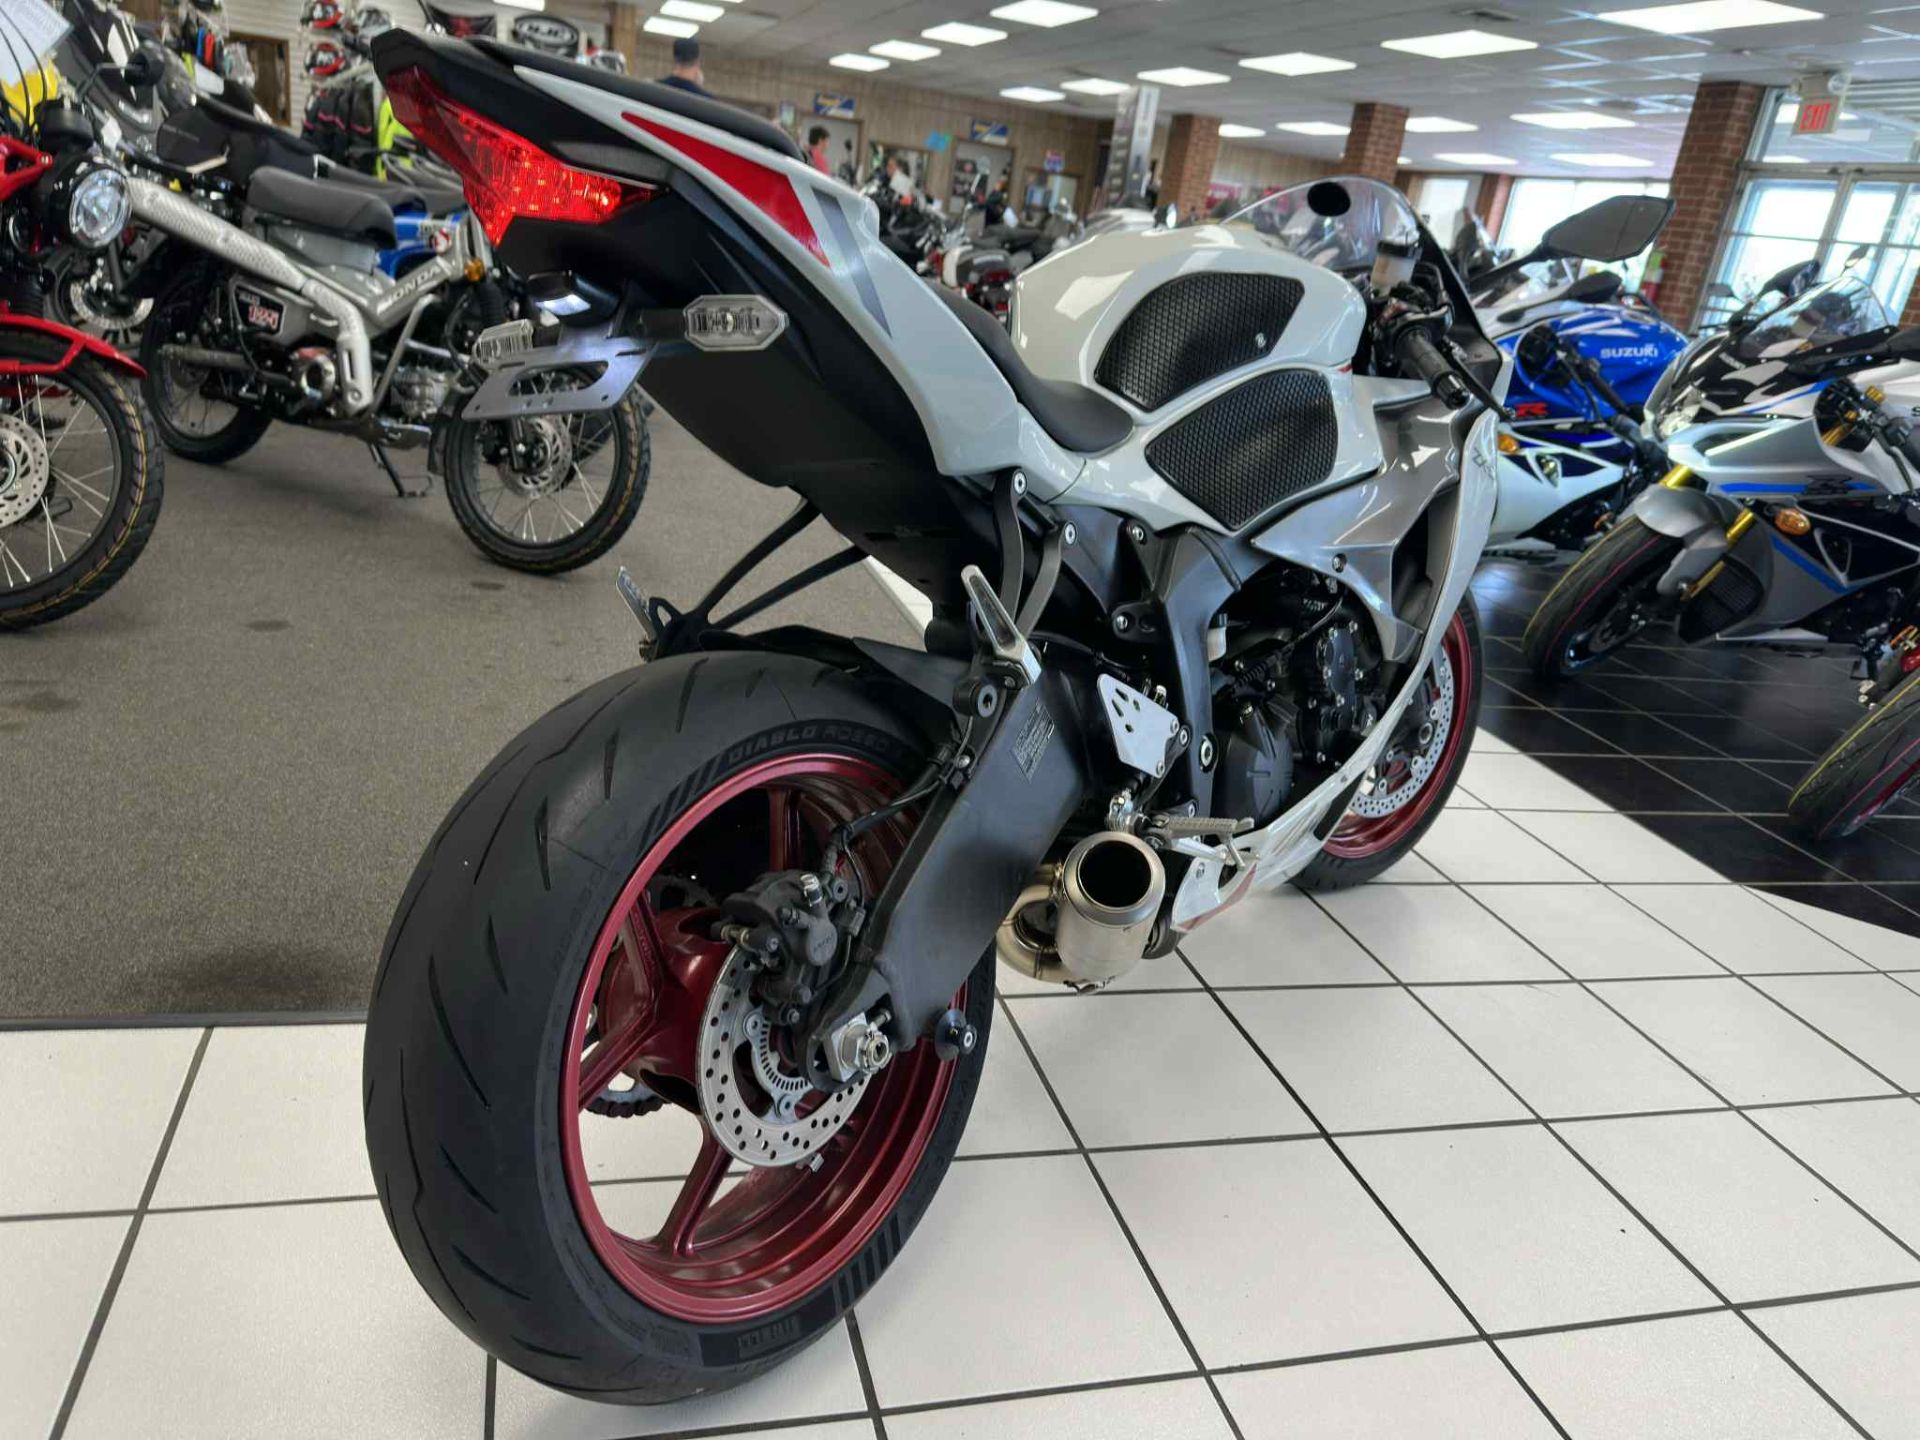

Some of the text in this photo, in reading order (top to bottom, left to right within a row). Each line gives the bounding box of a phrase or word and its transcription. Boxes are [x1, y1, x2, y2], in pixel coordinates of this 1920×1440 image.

[1800, 102, 1830, 130] EXIT
[1600, 343, 1659, 359] SUZUKI
[728, 724, 890, 763] DIABLO ROSSO
